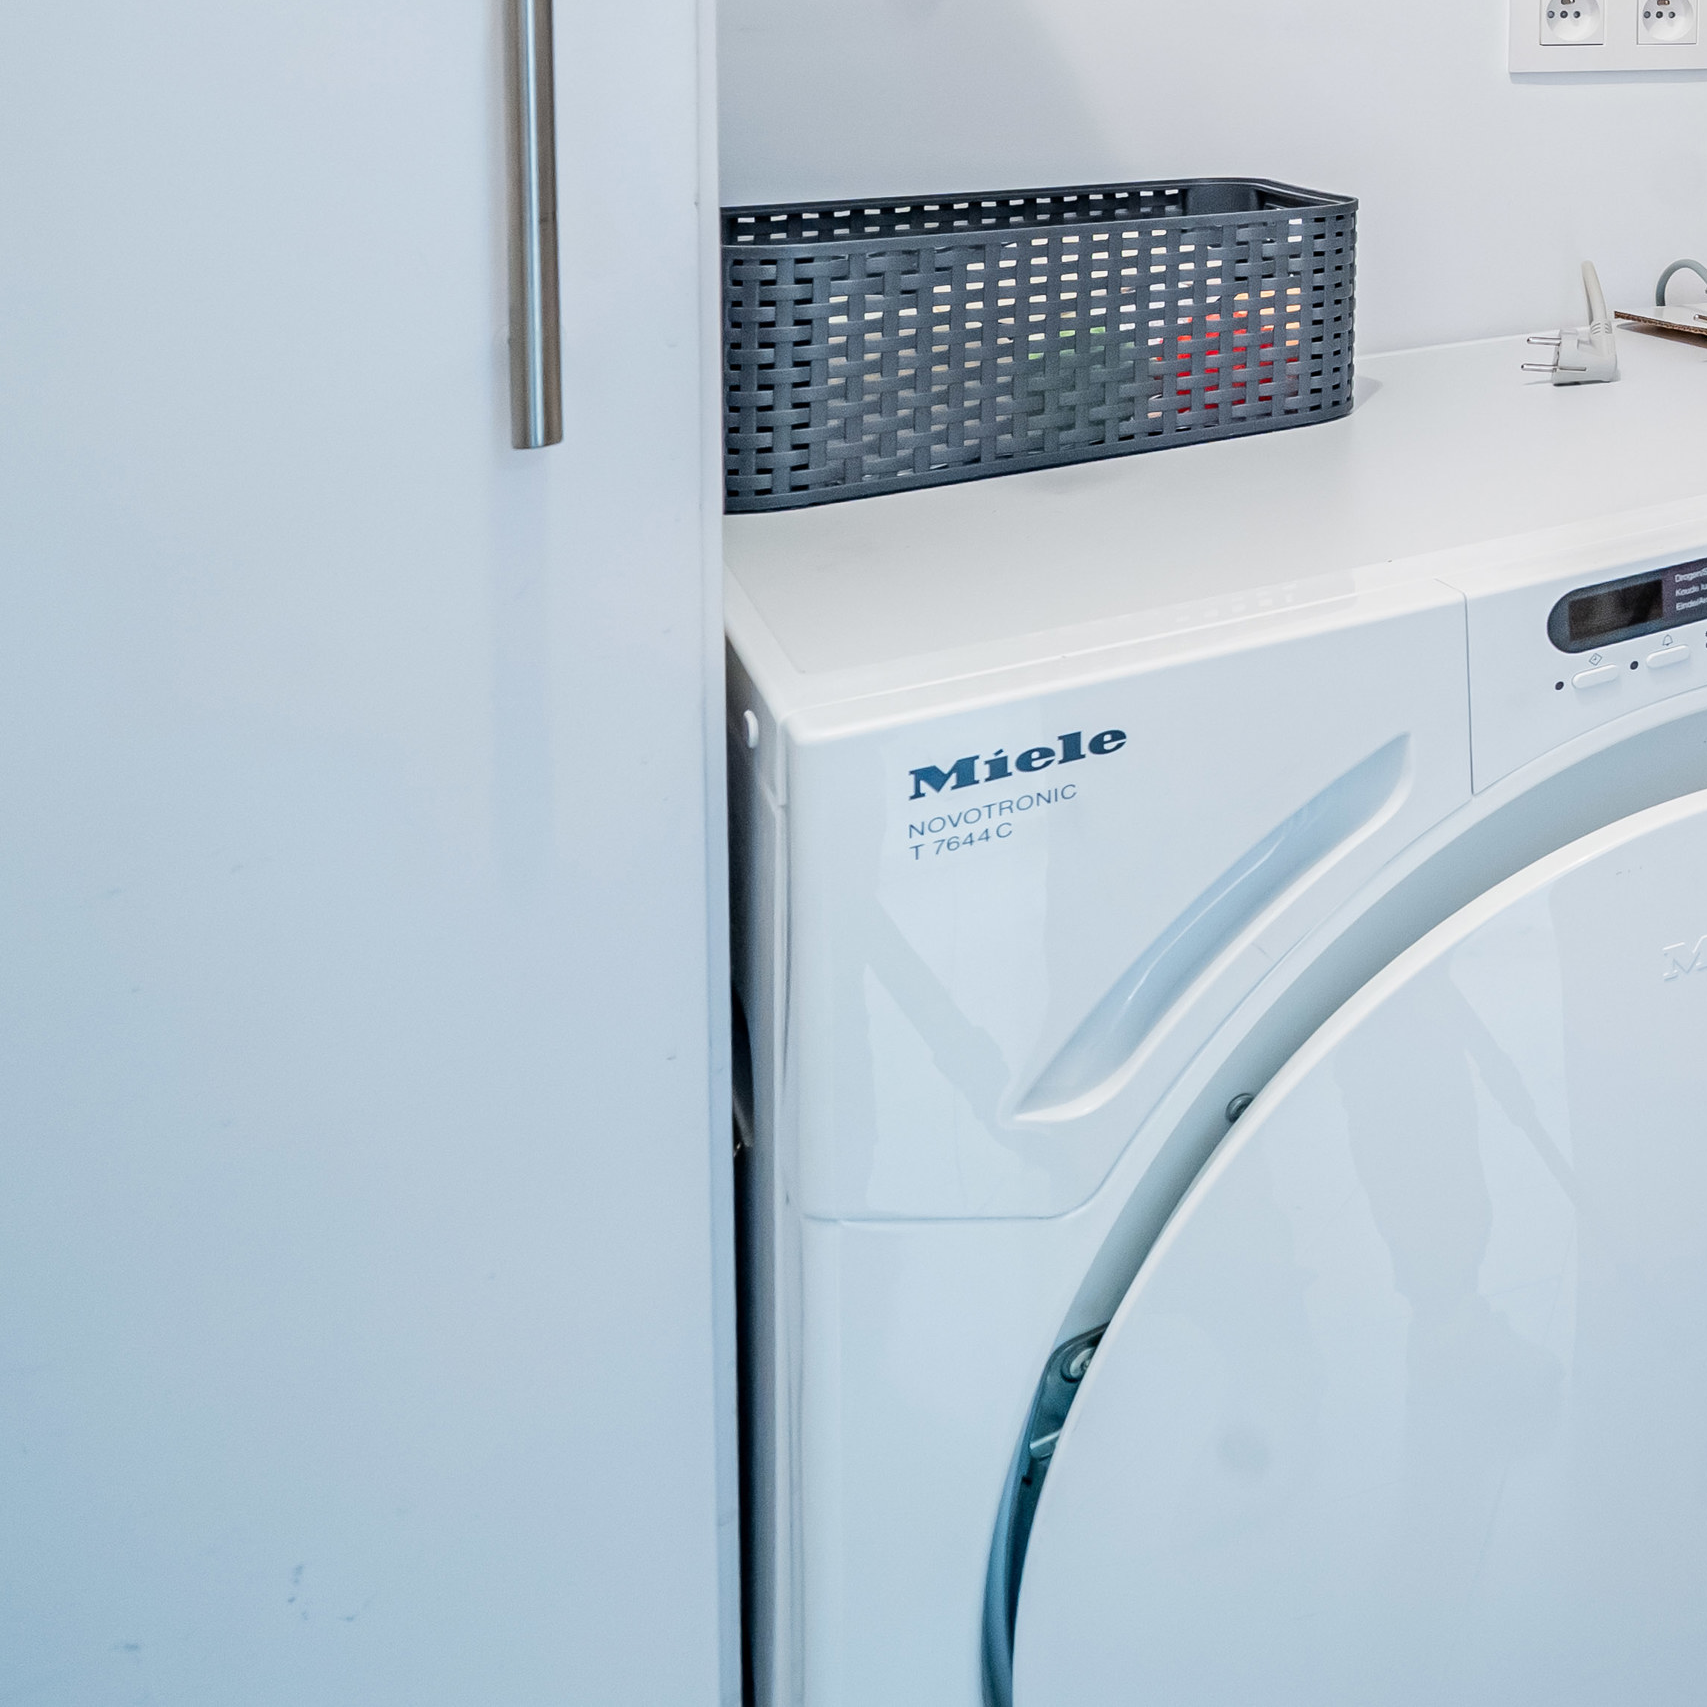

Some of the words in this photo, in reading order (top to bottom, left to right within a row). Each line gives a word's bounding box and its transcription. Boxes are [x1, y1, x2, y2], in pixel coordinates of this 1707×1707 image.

[908, 729, 1128, 801] Miele
[908, 784, 1079, 839] NOVOTRONIC
[909, 844, 926, 860] T
